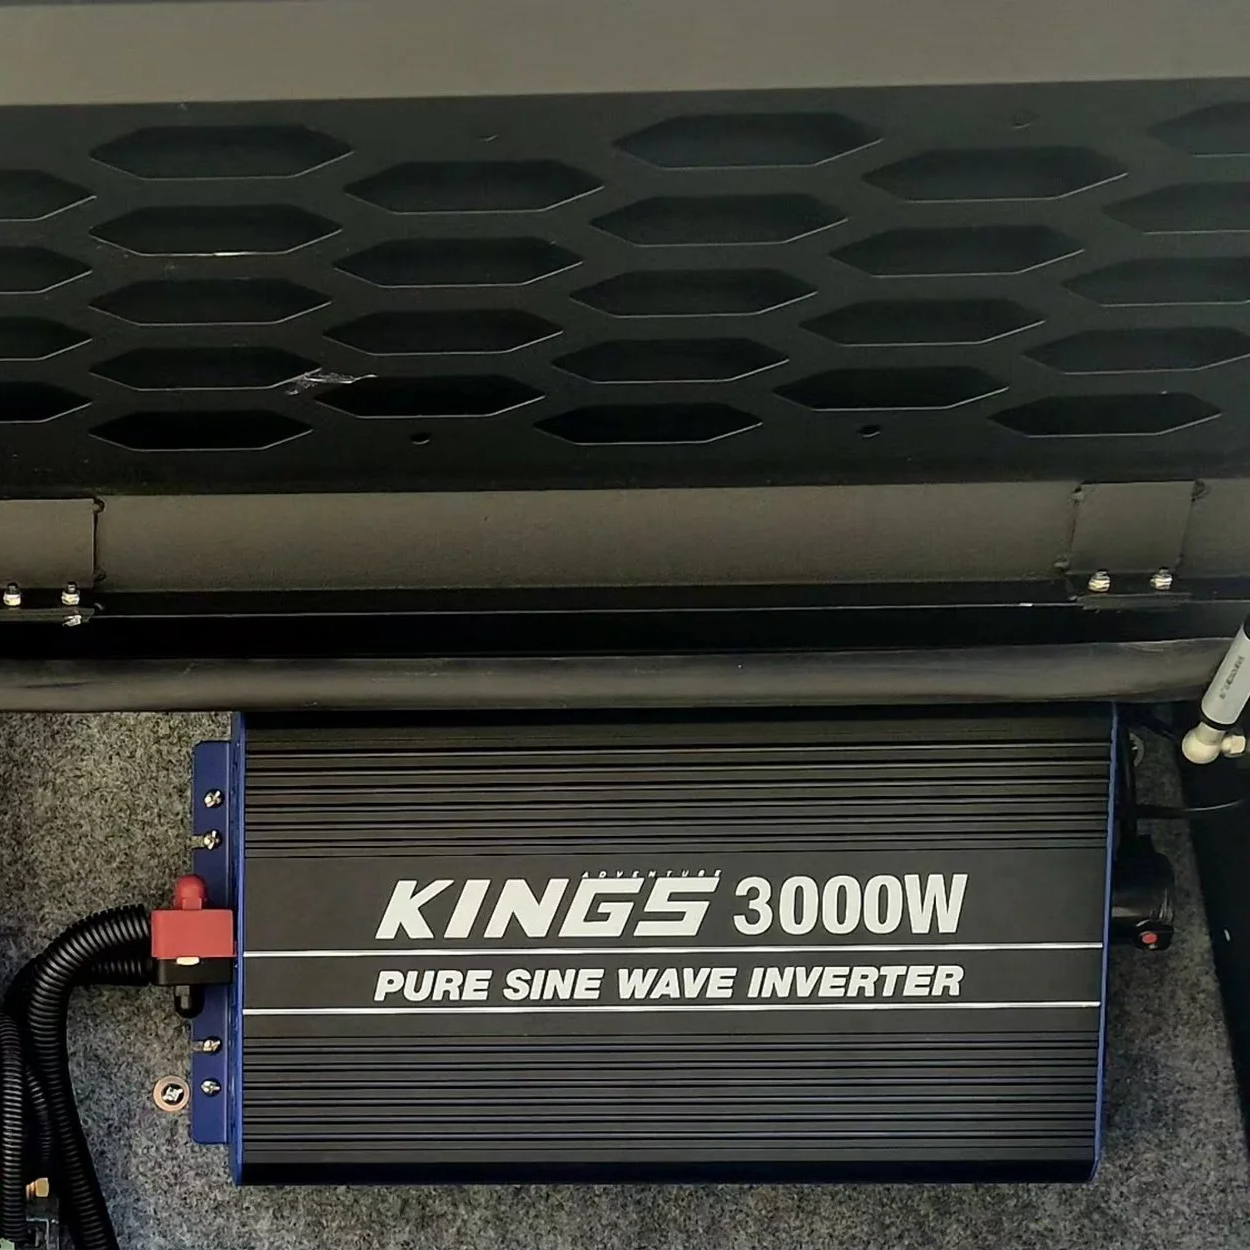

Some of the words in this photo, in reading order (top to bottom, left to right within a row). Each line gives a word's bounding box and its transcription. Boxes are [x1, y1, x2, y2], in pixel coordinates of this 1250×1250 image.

[581, 869, 722, 878] ADVENTURE
[375, 877, 720, 940] KINGS
[733, 873, 968, 935] 3000W
[374, 969, 493, 1001] PURE
[503, 969, 605, 1001] SINE
[618, 967, 738, 999] WAVE
[748, 965, 964, 998] INVERTER
